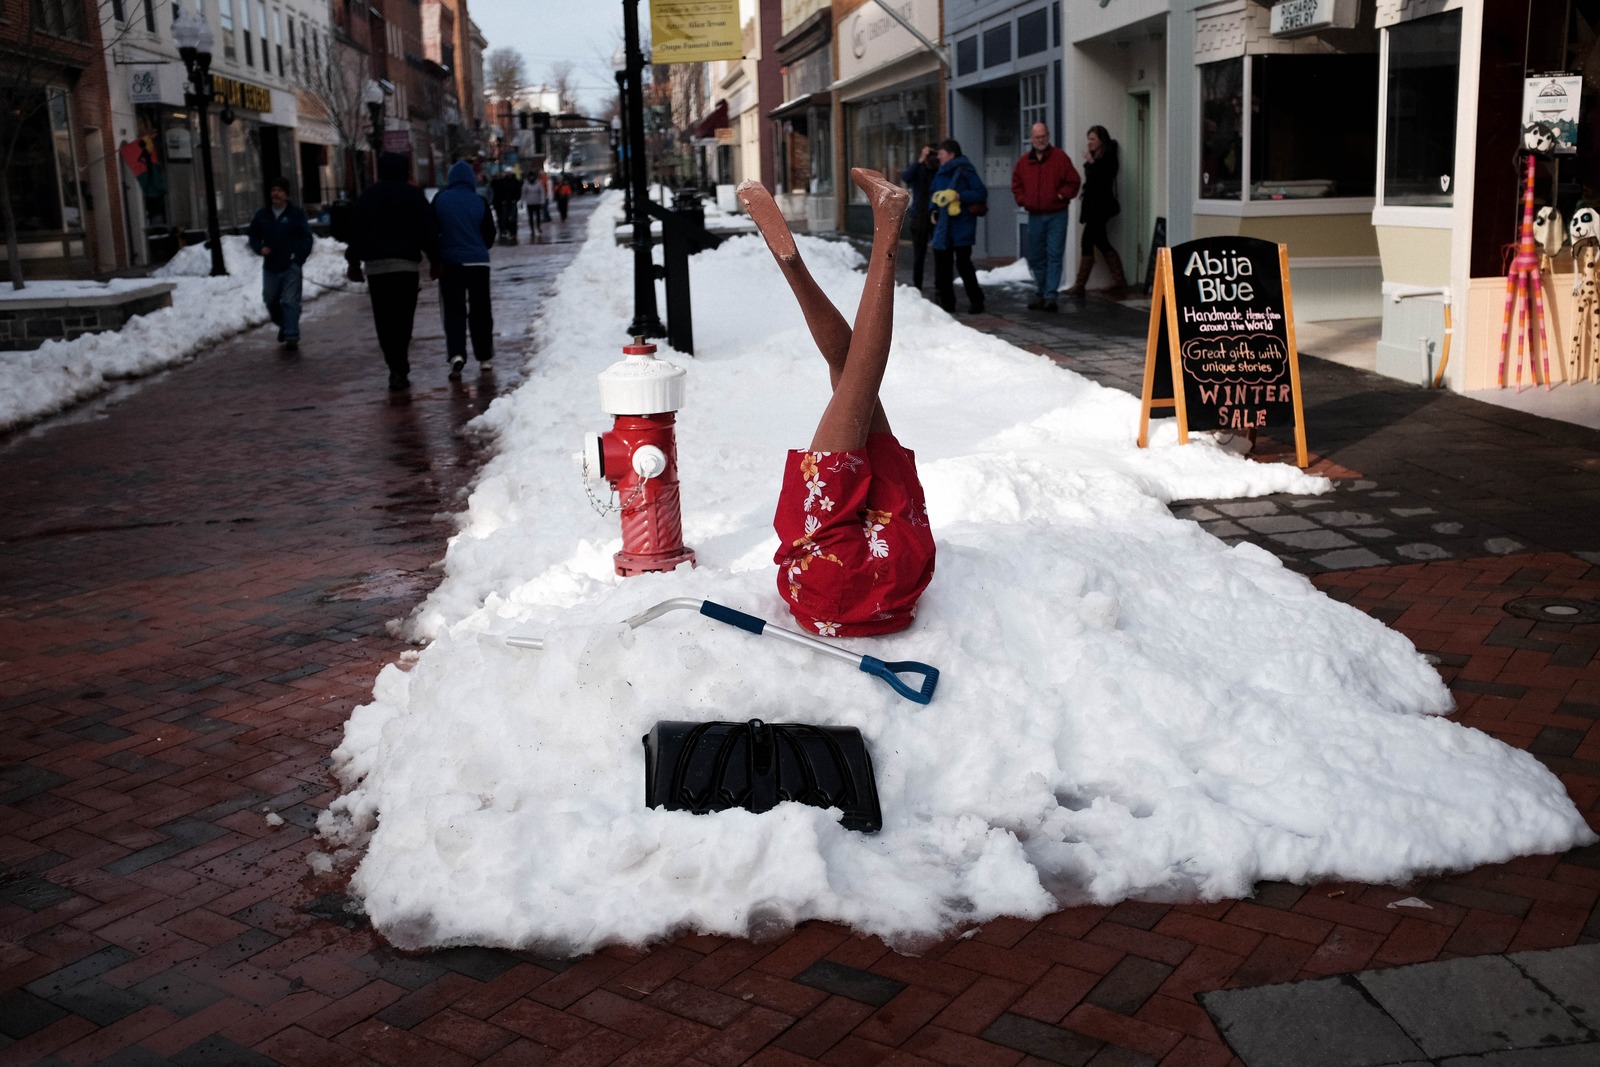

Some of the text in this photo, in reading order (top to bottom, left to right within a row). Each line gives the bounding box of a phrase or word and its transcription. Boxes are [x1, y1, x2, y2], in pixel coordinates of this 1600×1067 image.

[1281, 10, 1315, 30] JEWELRY
[1184, 250, 1253, 281] Abija
[1197, 278, 1254, 303] Blue
[1183, 306, 1281, 323] Handmade items from
[1199, 319, 1274, 332] around the World
[1187, 341, 1282, 363] Great gifts with
[1202, 361, 1272, 374] unique stories
[1199, 384, 1290, 406] WINTER
[1218, 406, 1267, 428] SALE
